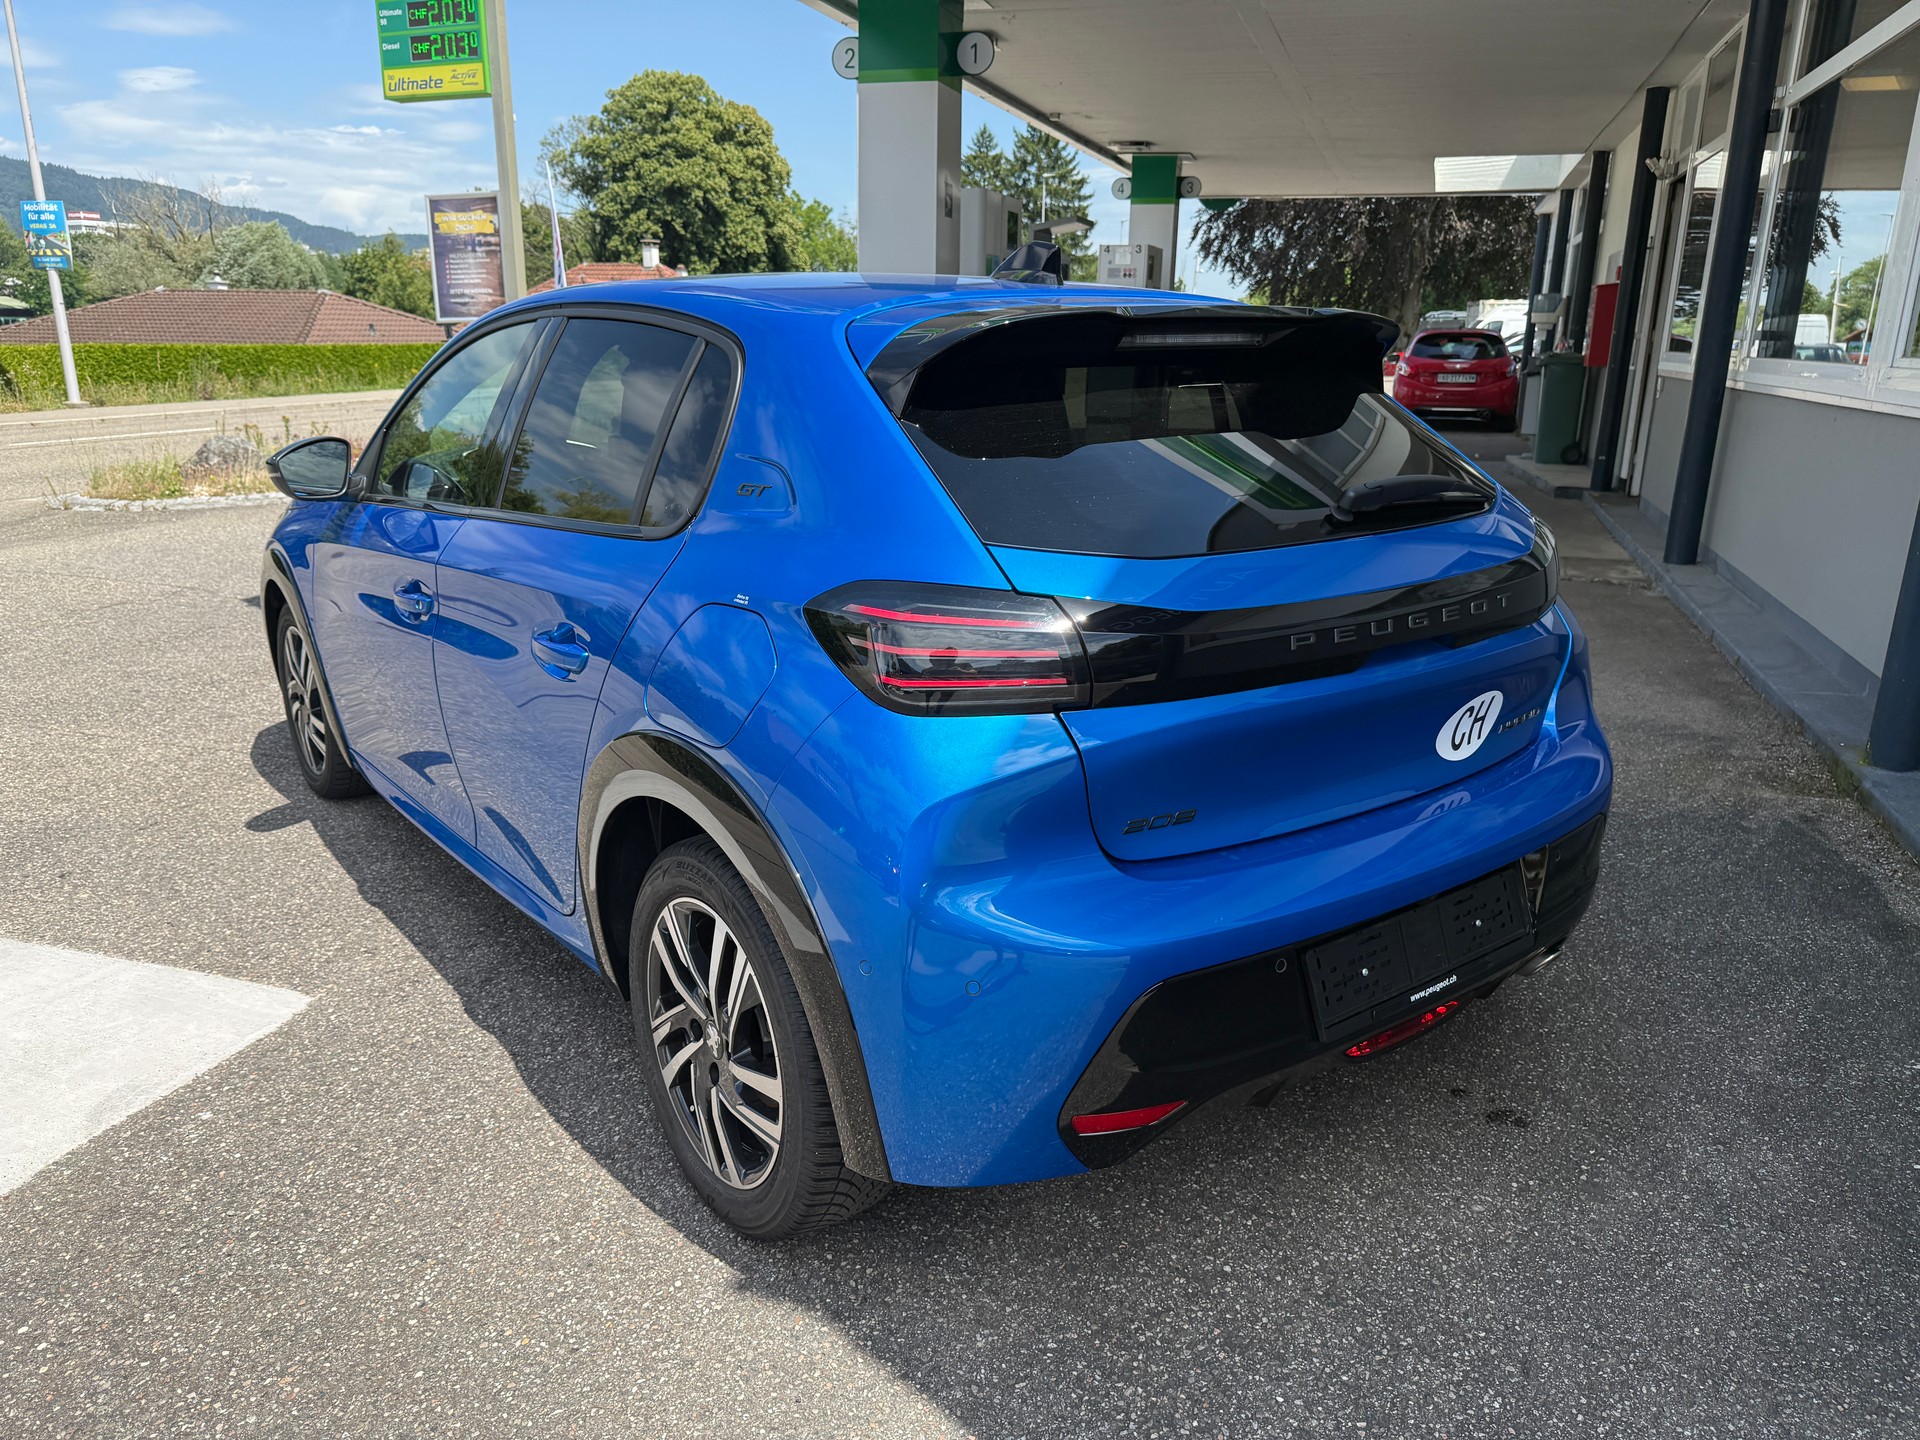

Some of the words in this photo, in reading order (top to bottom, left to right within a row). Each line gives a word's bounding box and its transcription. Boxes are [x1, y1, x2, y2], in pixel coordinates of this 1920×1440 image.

[379, 8, 402, 17] Ultimate
[409, 8, 427, 20] CHF
[382, 42, 400, 51] Diesel
[412, 42, 430, 54] CHF
[844, 48, 856, 69] 2
[970, 42, 978, 64] 1
[450, 72, 478, 80] ACTIVE
[388, 75, 444, 92] ultimate
[1117, 183, 1125, 195] 4
[1186, 181, 1194, 194] 3
[24, 203, 58, 211] Mobilität
[28, 213, 39, 221] für
[40, 213, 56, 221] alle
[1104, 245, 1110, 255] 4
[1135, 244, 1142, 254] 3
[736, 482, 773, 497] GT
[1290, 591, 1512, 650] PEUGEOT
[1451, 694, 1496, 751] CH
[1122, 808, 1197, 835] 208
[675, 860, 716, 886] BLIZZAK
[1410, 974, 1457, 1002] www.peugeot.ch
